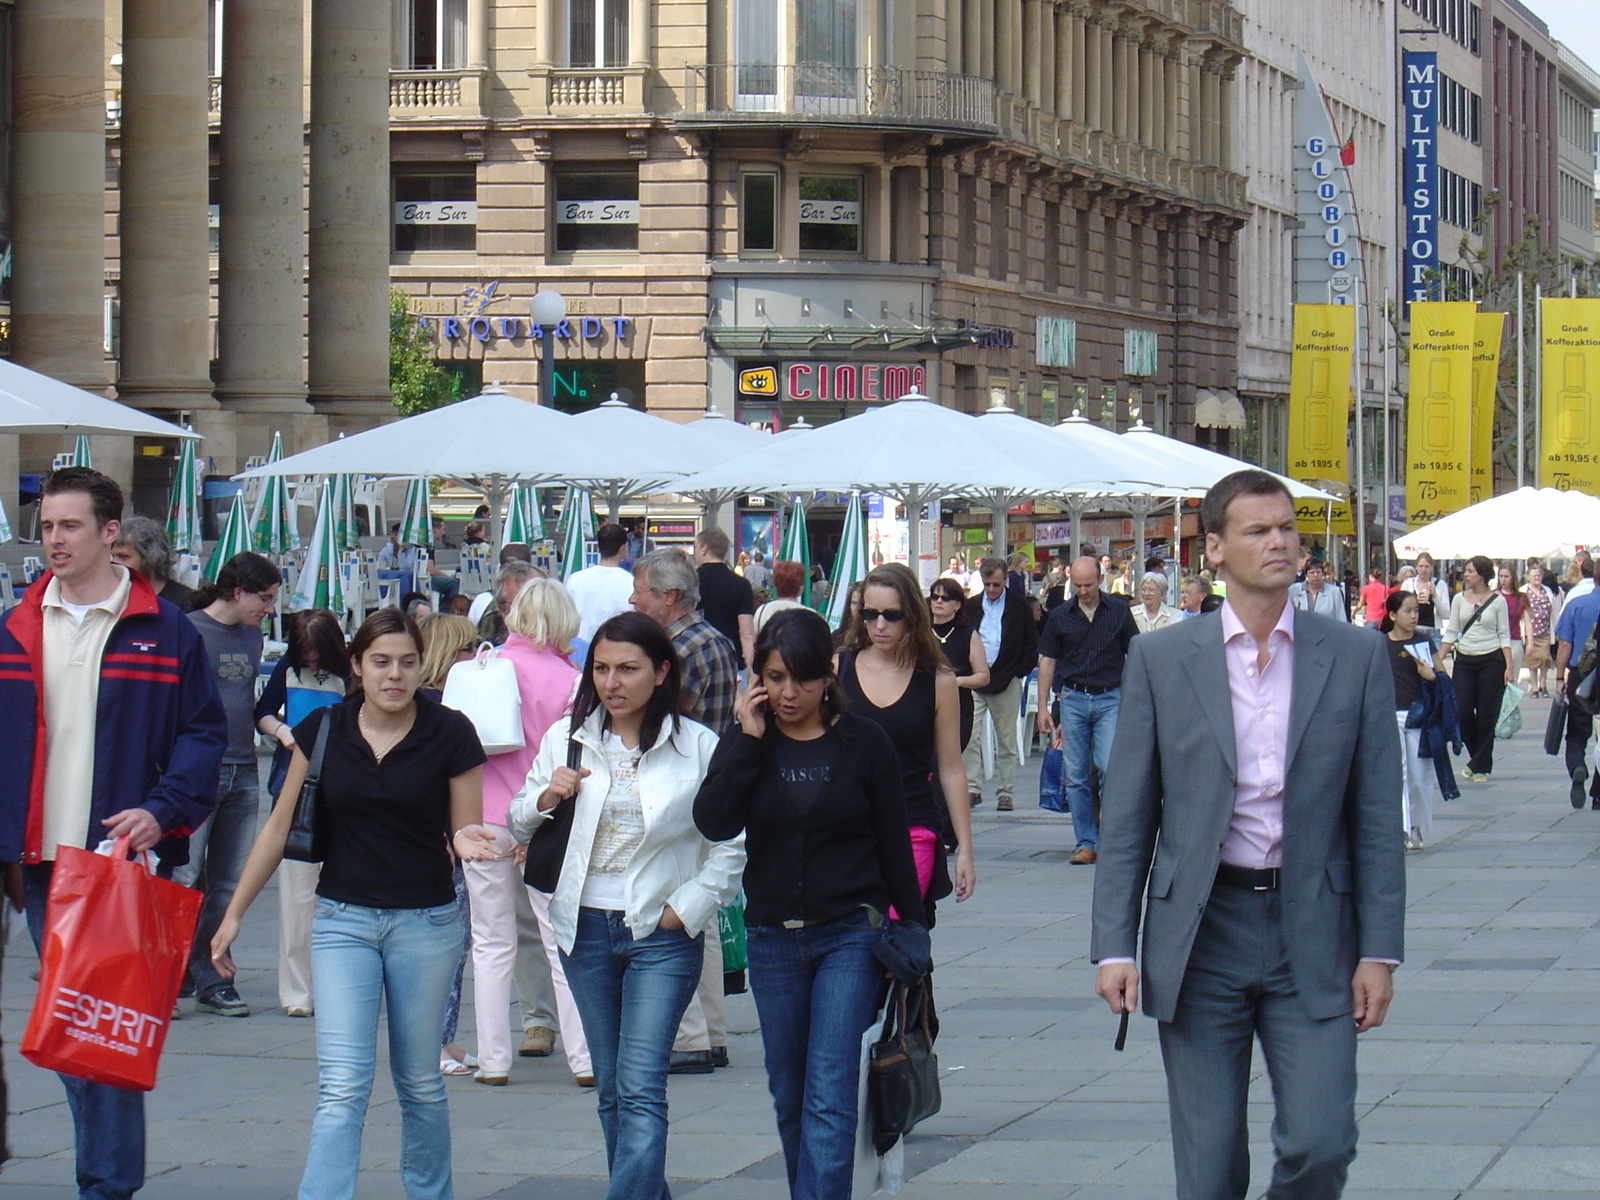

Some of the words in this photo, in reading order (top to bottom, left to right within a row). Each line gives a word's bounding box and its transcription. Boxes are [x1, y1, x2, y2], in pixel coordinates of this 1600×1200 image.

[1308, 138, 1347, 266] GLORIA
[403, 204, 432, 220] Bar
[438, 205, 468, 221] Sur
[565, 203, 594, 220] Bar
[600, 204, 630, 221] Sur
[800, 202, 825, 220] Bar
[830, 205, 857, 222] Sur
[411, 298, 445, 313] BAR
[418, 317, 629, 342] RQUARDT
[1311, 329, 1335, 339] Große
[1428, 329, 1455, 337] Große
[1561, 324, 1589, 333] Große
[1295, 343, 1349, 352] Kofferaktion
[1412, 343, 1470, 352] Kofferaktion
[788, 363, 926, 401] CINEMA
[1294, 459, 1308, 468] ab
[1413, 461, 1426, 470] ab
[1429, 461, 1454, 471] 19,95
[1457, 462, 1463, 471] €
[1548, 453, 1561, 462] ab
[1564, 454, 1590, 464] 19,95
[1592, 455, 1599, 464] €
[1418, 480, 1438, 500] 75
[1437, 485, 1458, 496] Jahre
[1552, 472, 1571, 492] 75
[1570, 477, 1594, 487] Jahre
[52, 986, 165, 1048] ESPRIT
